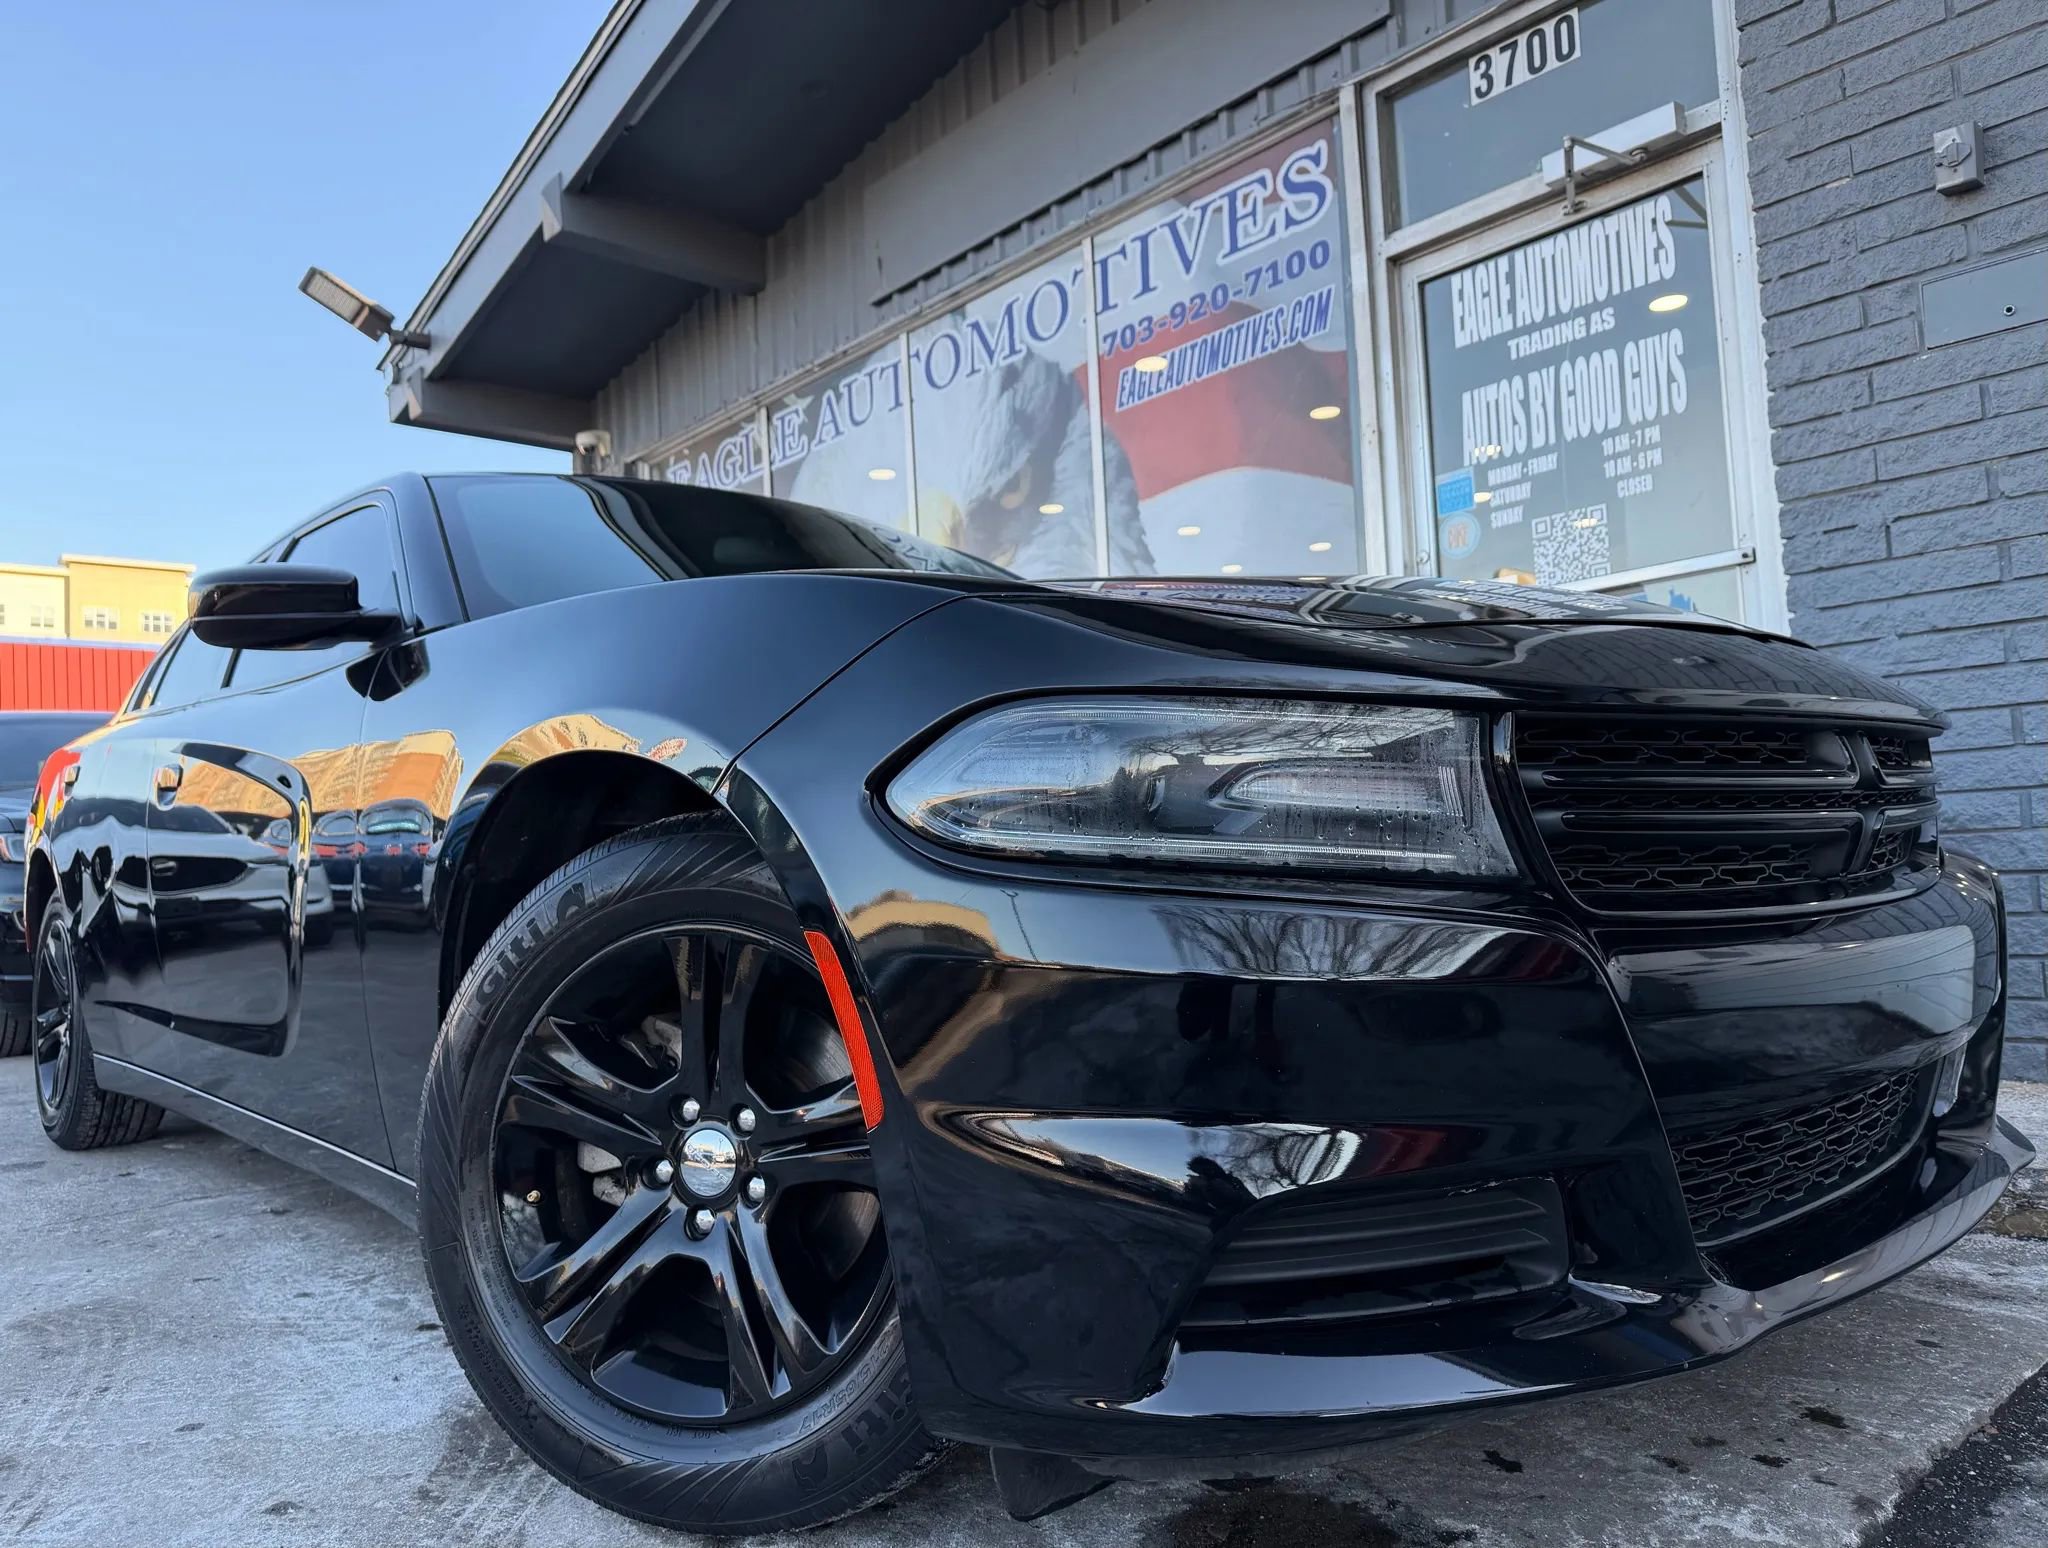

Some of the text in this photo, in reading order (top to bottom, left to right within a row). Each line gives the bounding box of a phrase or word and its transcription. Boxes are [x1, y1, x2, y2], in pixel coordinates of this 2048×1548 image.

[1472, 13, 1577, 100] 3700
[811, 139, 1333, 450] AUTOMOTIVES
[1103, 239, 1331, 358] 703-920-7100
[1451, 195, 1677, 348] EAGLE AUTOMOTIVES
[1116, 285, 1335, 411] EAGLEAUTOMOTIVES.COM
[1507, 306, 1616, 361] TRADING AS
[1461, 328, 1687, 466] AUTOS BY GOOD GUYS
[1615, 432, 1630, 453] AM
[1645, 424, 1661, 445] PM
[1617, 455, 1632, 475] AM
[1646, 447, 1662, 467] PM
[1617, 473, 1653, 498] CLOSED
